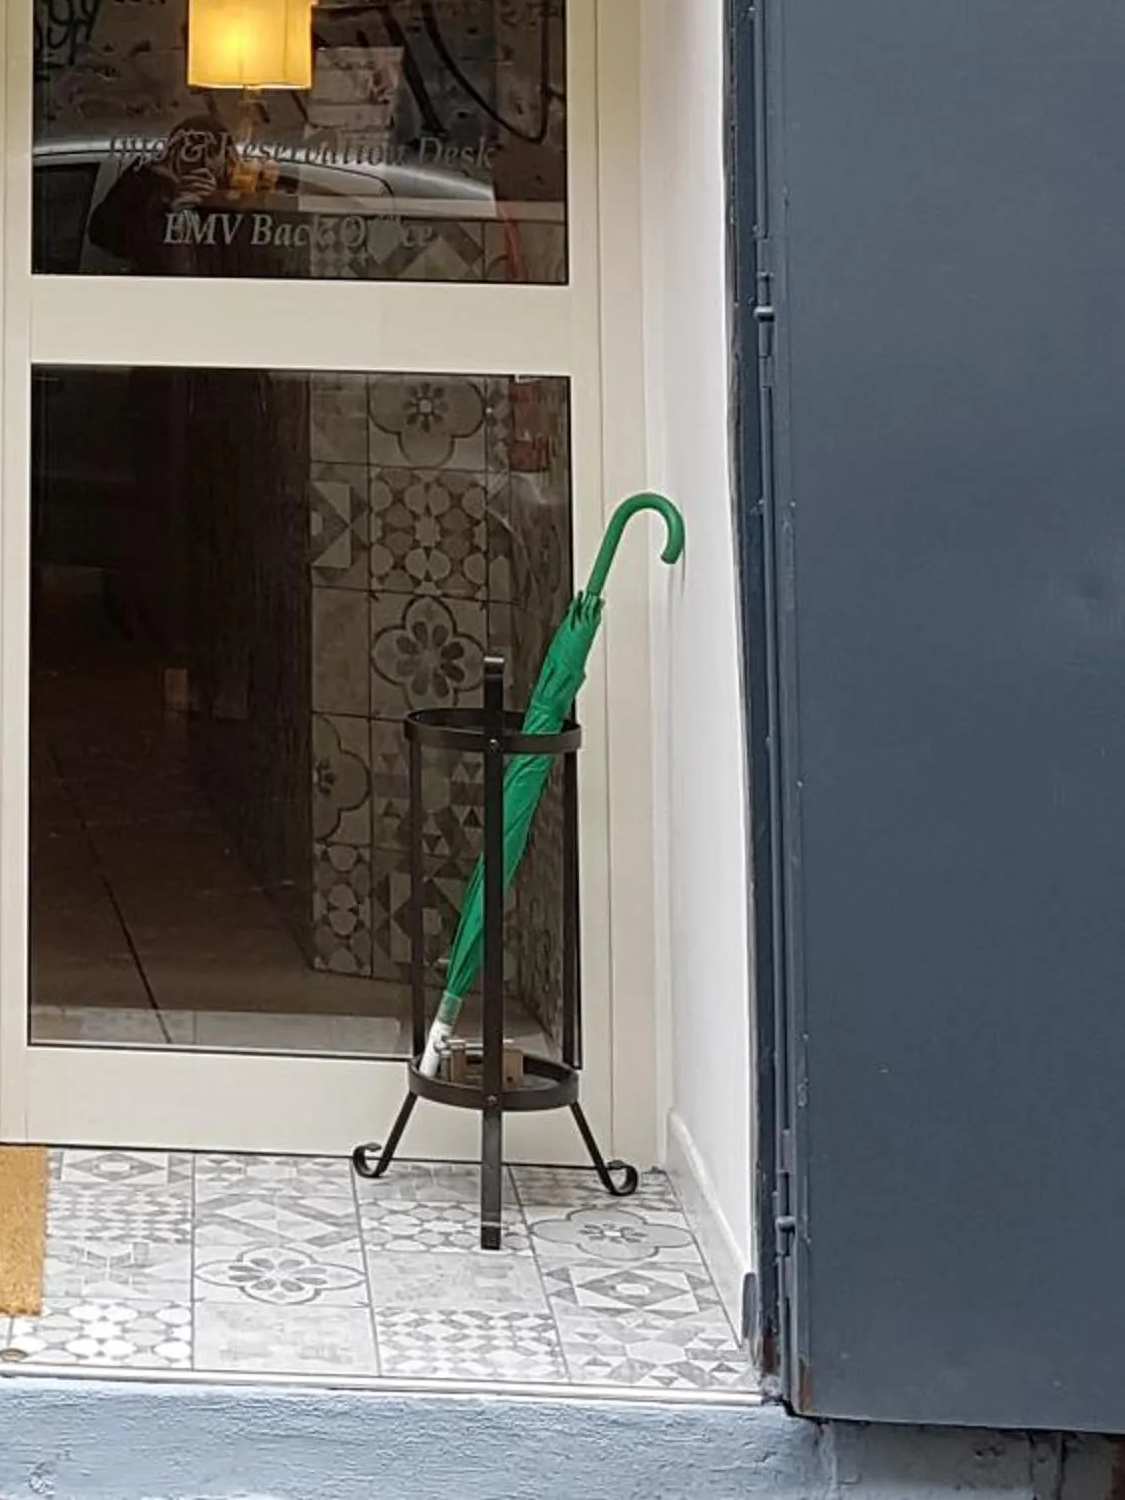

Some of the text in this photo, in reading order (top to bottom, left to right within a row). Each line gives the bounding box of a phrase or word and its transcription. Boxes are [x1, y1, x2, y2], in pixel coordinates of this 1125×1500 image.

[417, 134, 496, 169] Desk
[162, 211, 245, 247] EMV
[251, 212, 335, 248] Back
